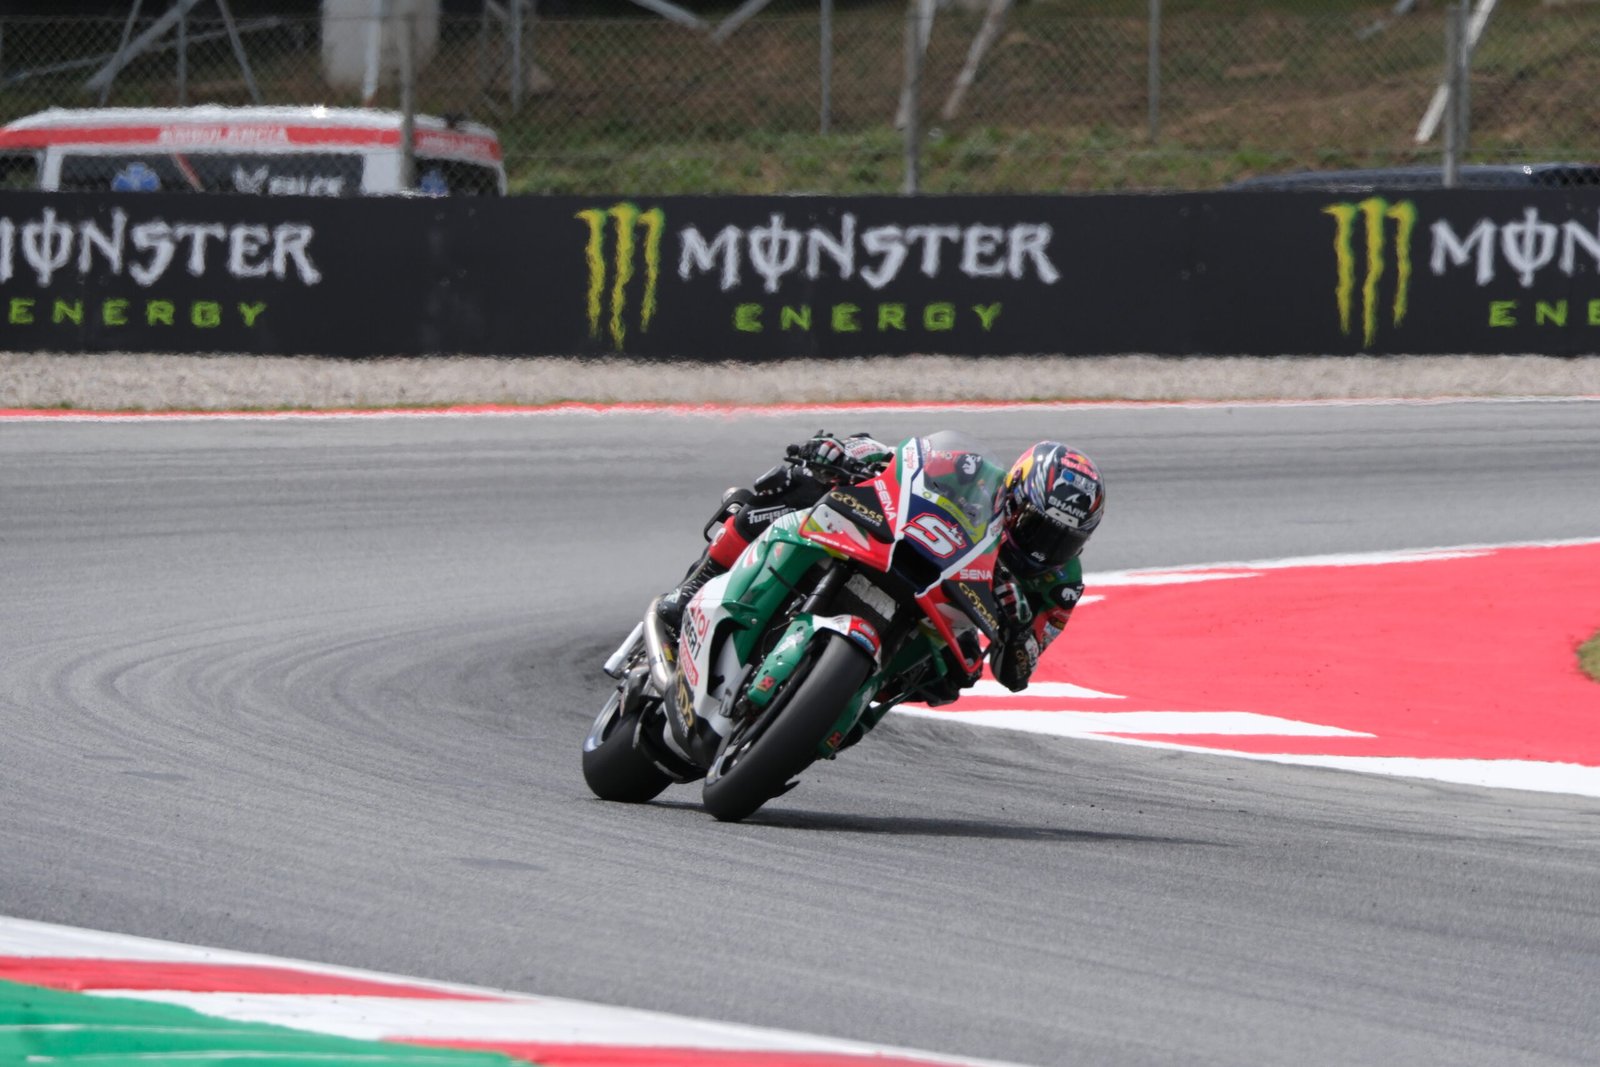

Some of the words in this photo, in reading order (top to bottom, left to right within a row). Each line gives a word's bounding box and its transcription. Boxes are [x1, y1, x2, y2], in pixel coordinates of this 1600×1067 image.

[0, 207, 323, 288] ONSTER
[678, 212, 1060, 293] MONSTER
[8, 298, 266, 328] ENERGY
[733, 302, 1001, 333] ENERGY
[874, 478, 897, 521] SENA
[1047, 495, 1087, 520] SHARK
[959, 569, 993, 580] SENA
